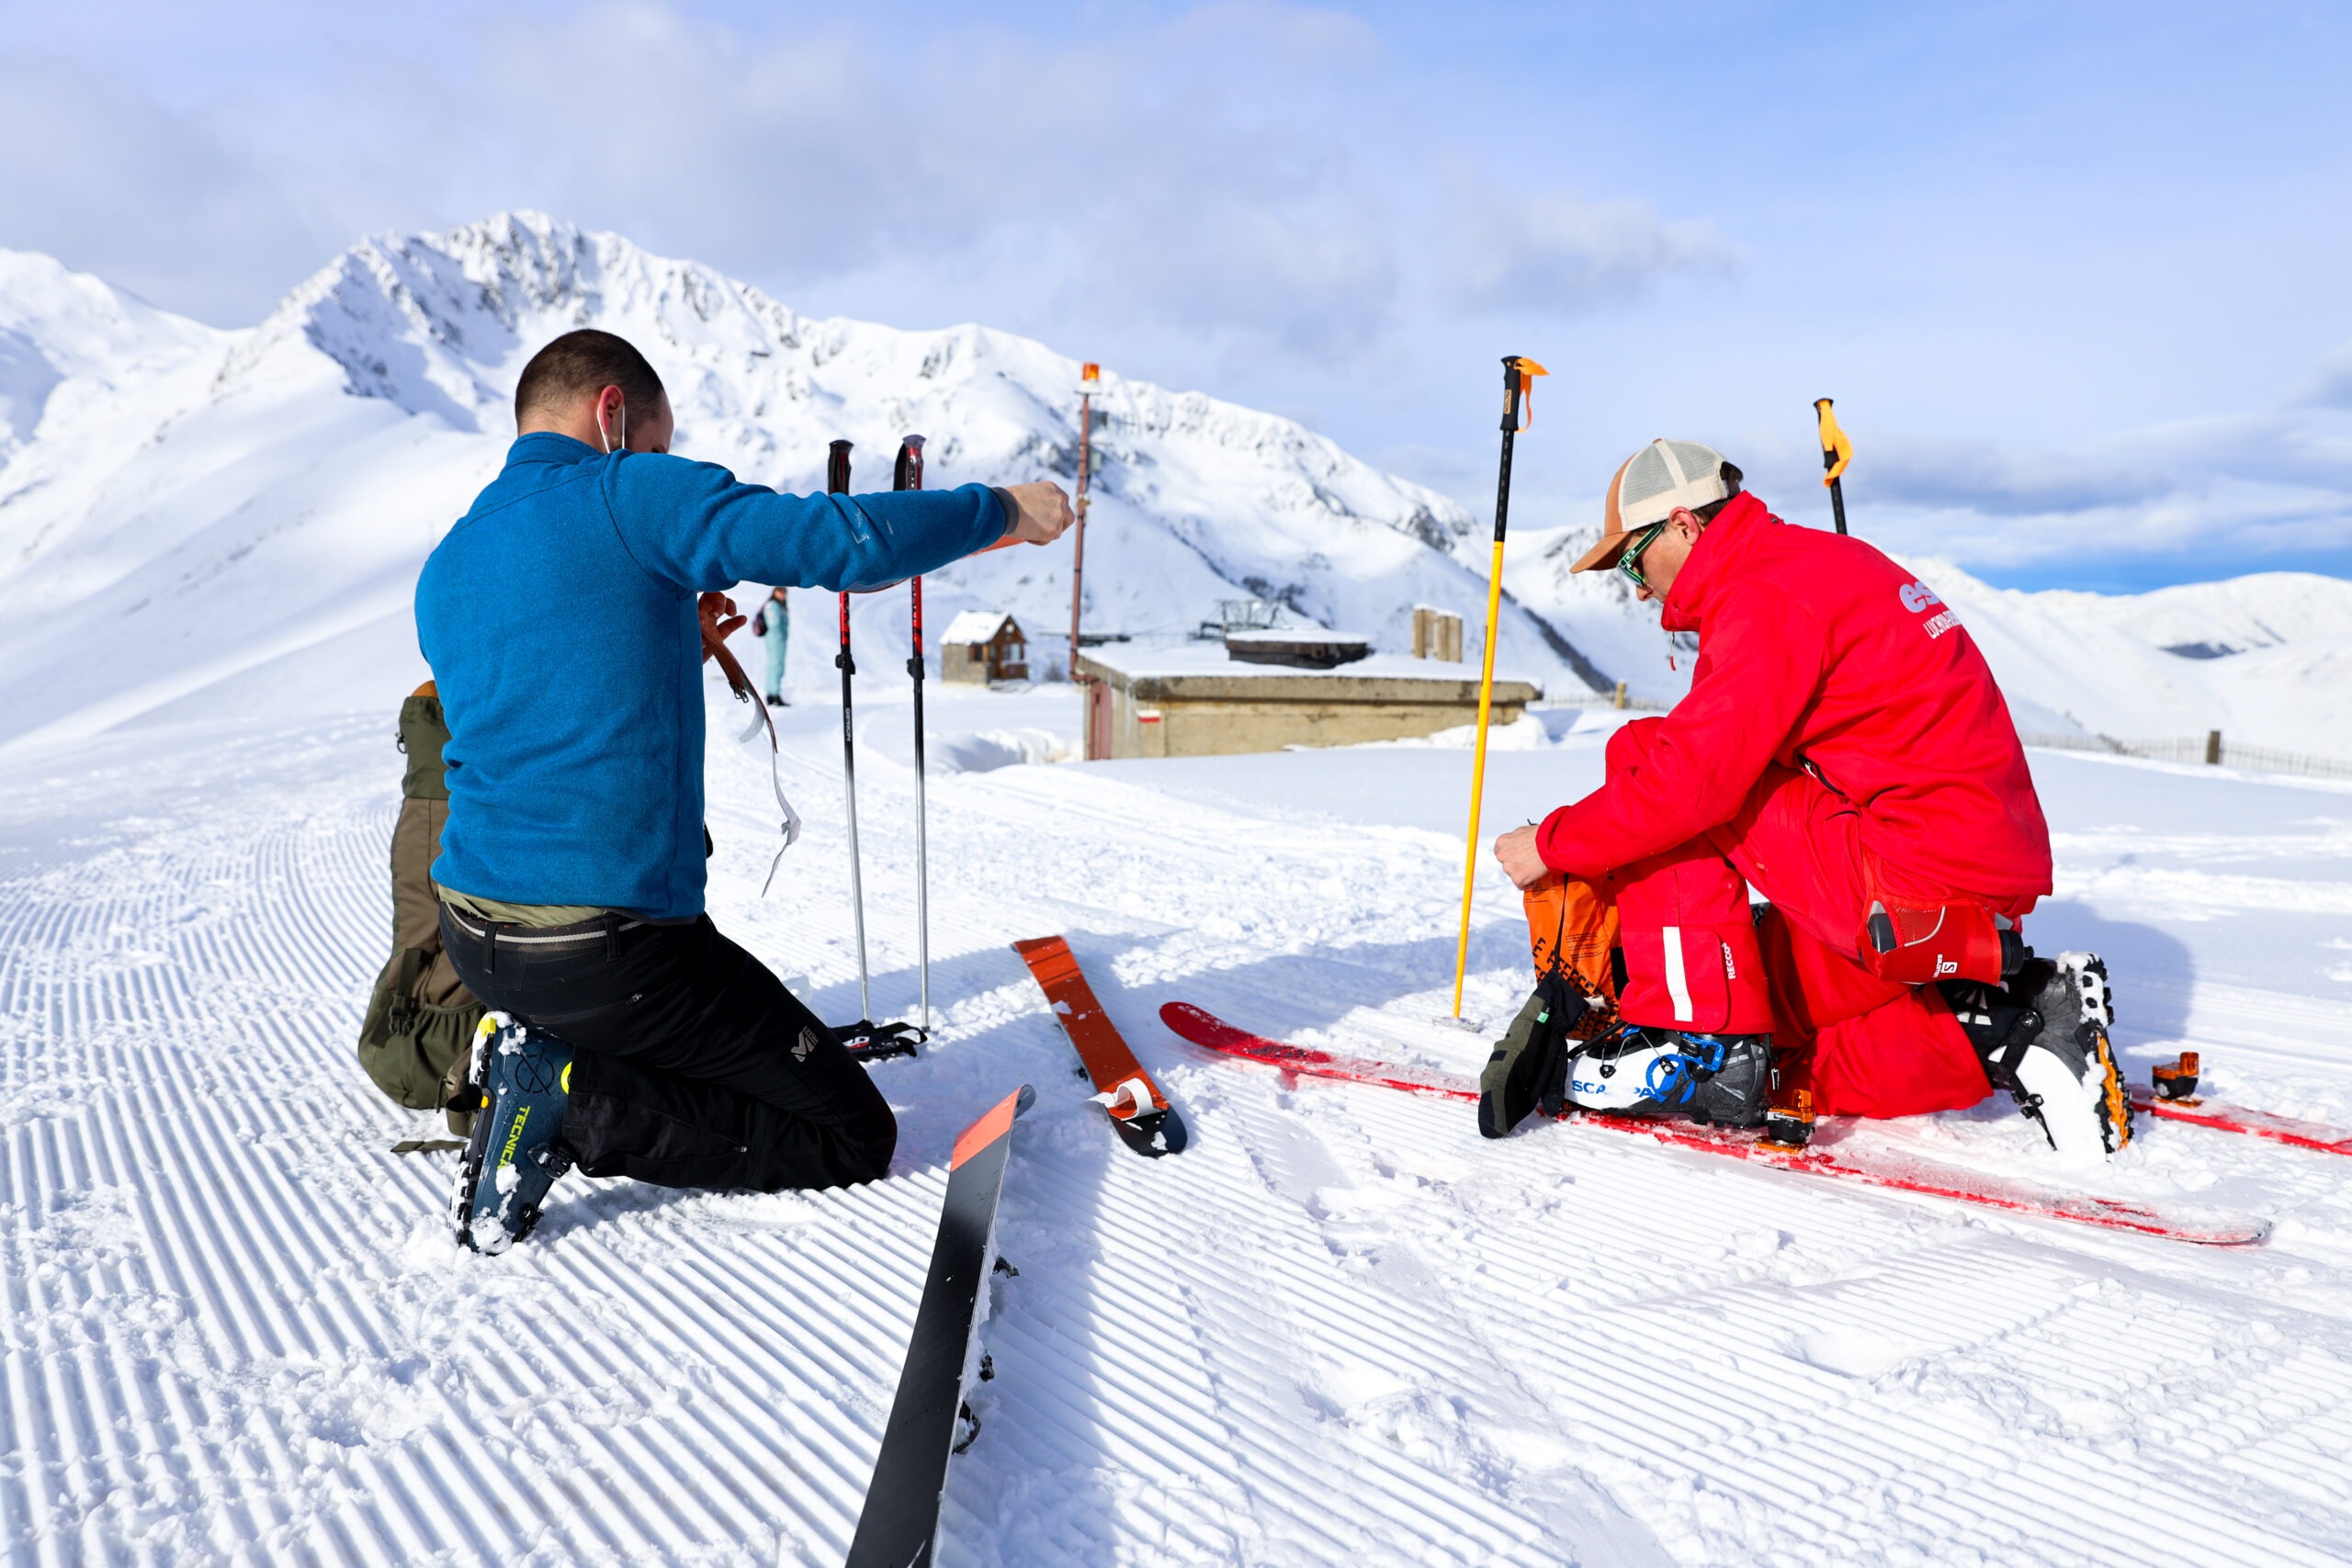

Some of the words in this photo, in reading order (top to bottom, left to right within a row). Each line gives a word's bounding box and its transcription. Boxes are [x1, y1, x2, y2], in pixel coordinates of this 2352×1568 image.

[1724, 945, 1736, 979] RECCO
[1572, 1079, 1657, 1099] SCAPA
[497, 1106, 531, 1169] TECNICA
